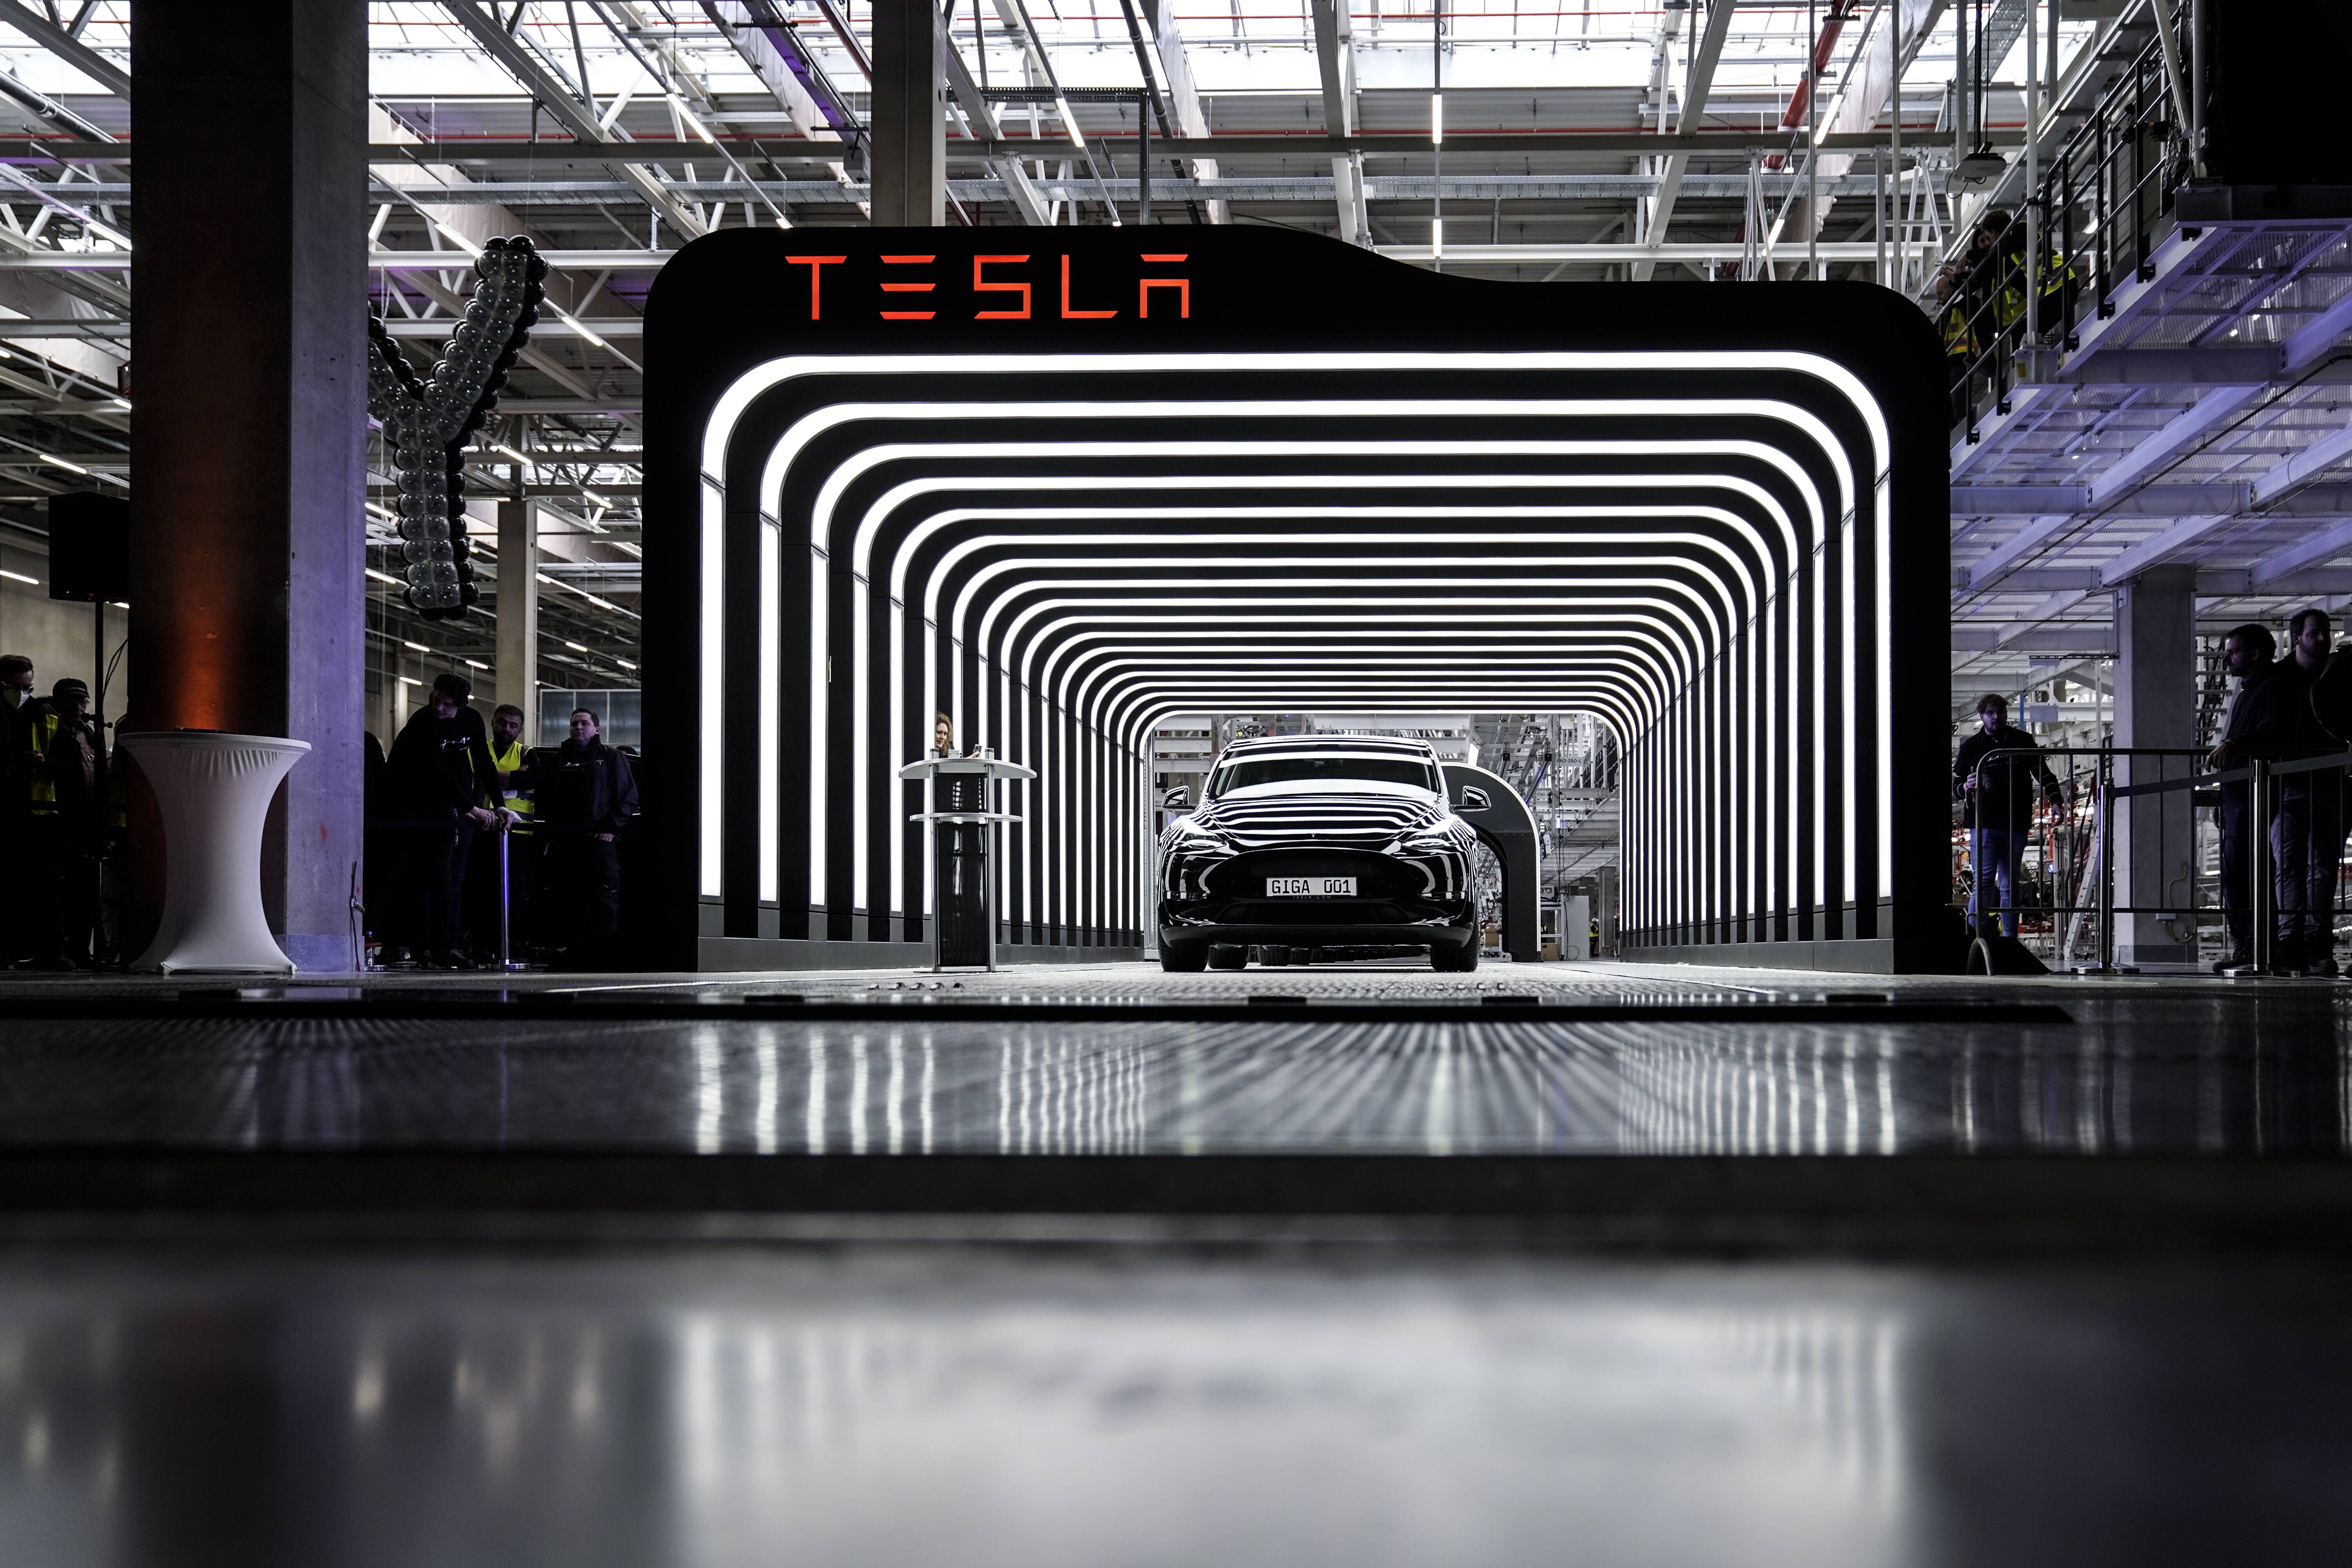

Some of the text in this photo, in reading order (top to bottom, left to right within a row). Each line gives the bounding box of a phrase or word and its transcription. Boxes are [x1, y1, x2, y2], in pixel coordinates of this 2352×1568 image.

[785, 254, 1189, 320] TESLA
[1272, 879, 1351, 893] GIGA 001
